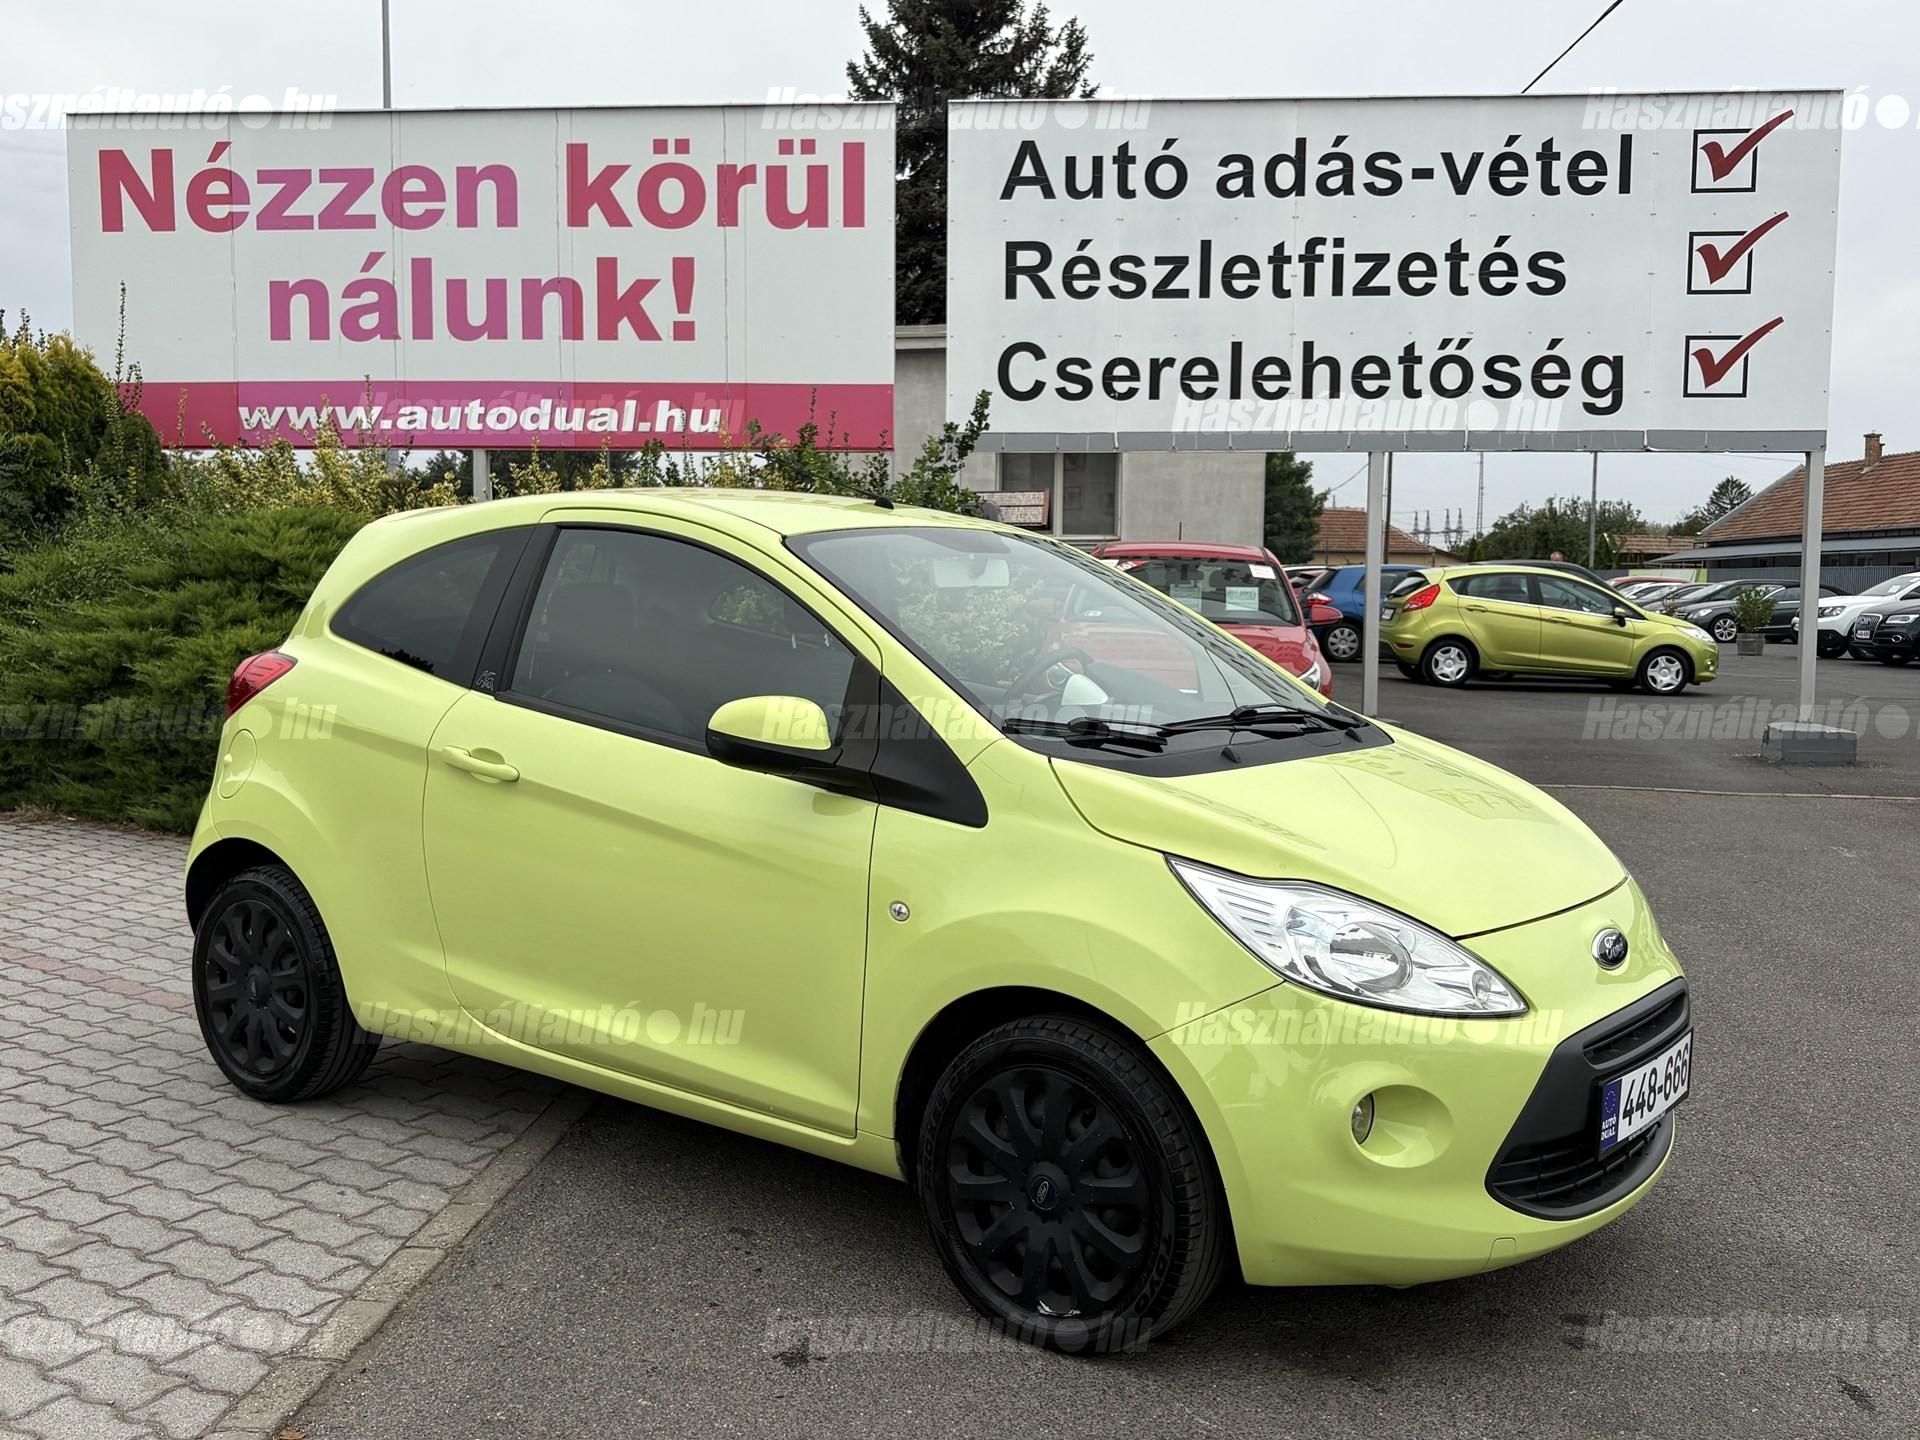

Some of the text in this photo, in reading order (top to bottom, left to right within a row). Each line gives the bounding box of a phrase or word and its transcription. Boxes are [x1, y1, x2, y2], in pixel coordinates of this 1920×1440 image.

[98, 139, 866, 233] Nézzen körül
[999, 134, 1633, 200] Autó adás-vétel
[269, 251, 696, 342] nálunk!
[1004, 236, 1567, 300] Részletfizetés
[238, 399, 722, 433] www.autodual.hu
[997, 338, 1625, 416] Cserelehetőség
[1622, 1042, 1689, 1126] 448-666
